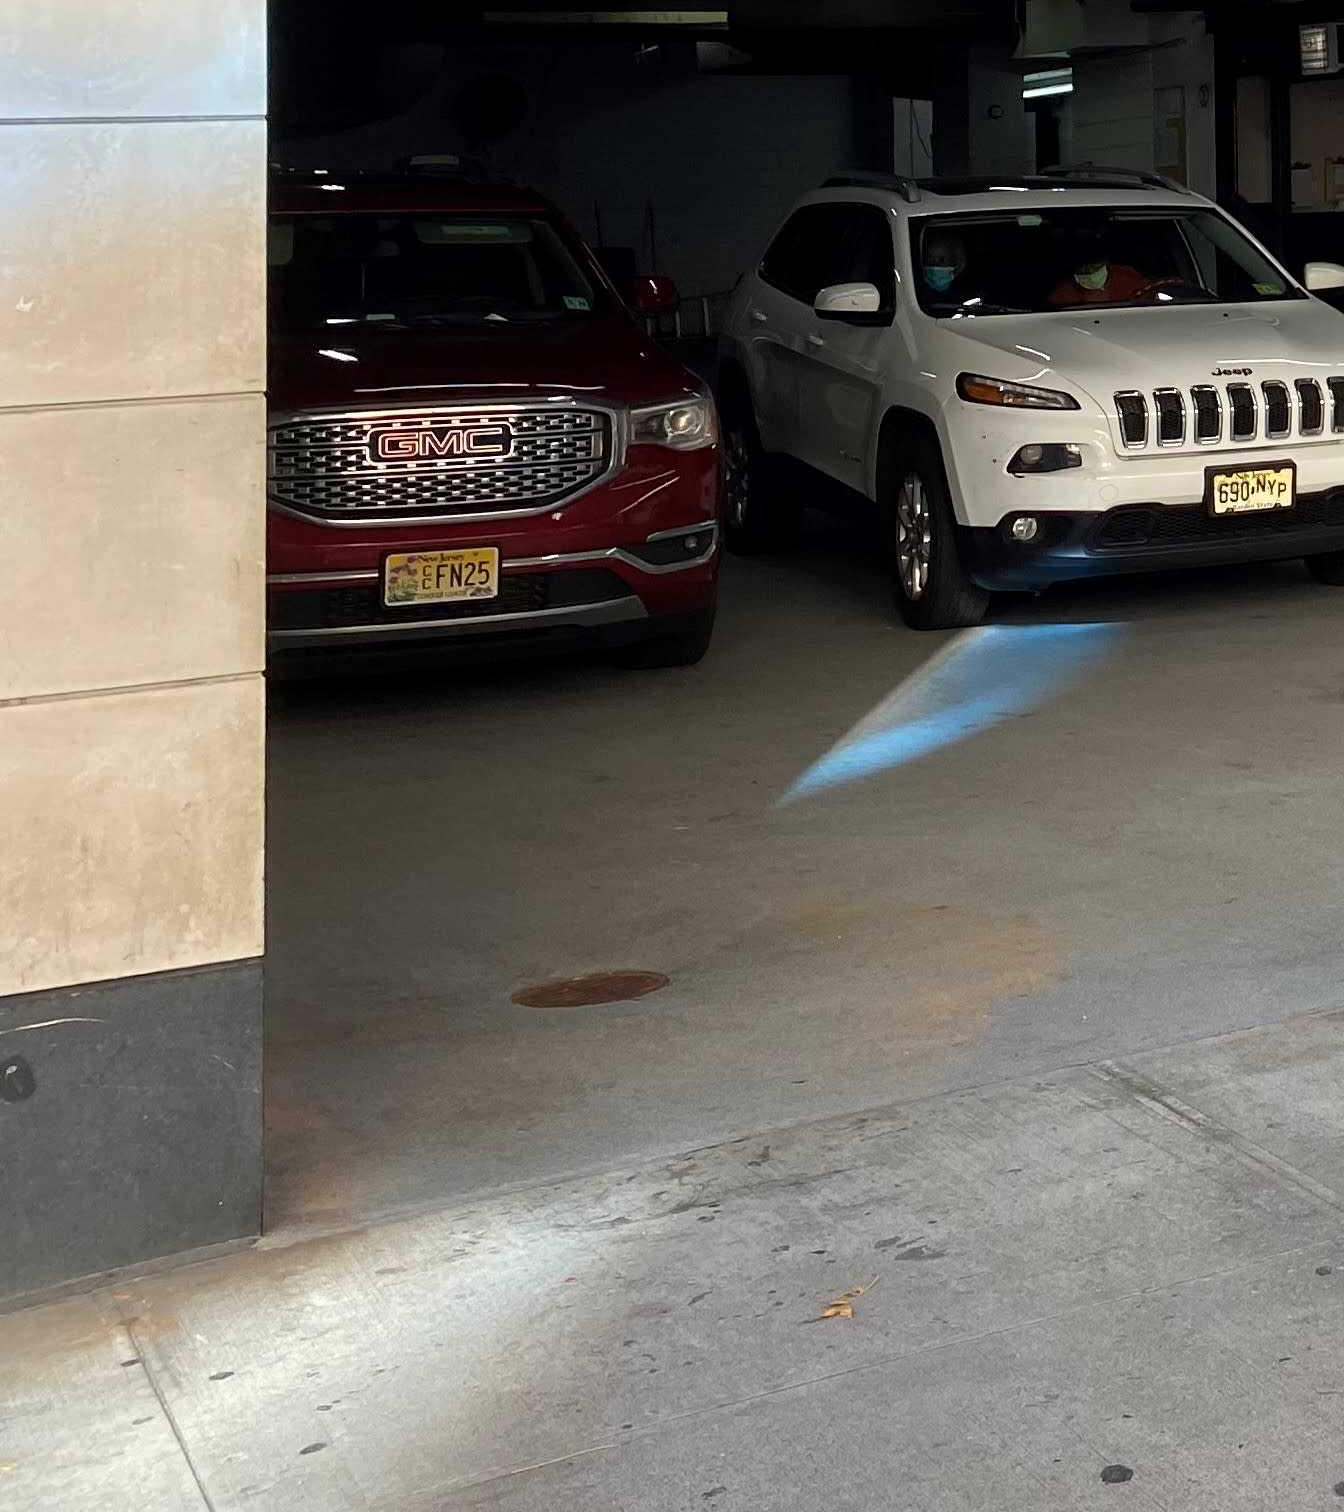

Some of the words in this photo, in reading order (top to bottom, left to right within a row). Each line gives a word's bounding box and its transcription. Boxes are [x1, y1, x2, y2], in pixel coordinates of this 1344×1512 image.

[1211, 368, 1253, 376] Jeep
[378, 427, 503, 458] GMC
[1219, 481, 1249, 503] 690
[1256, 475, 1287, 498] NYP
[435, 561, 489, 589] FN25
